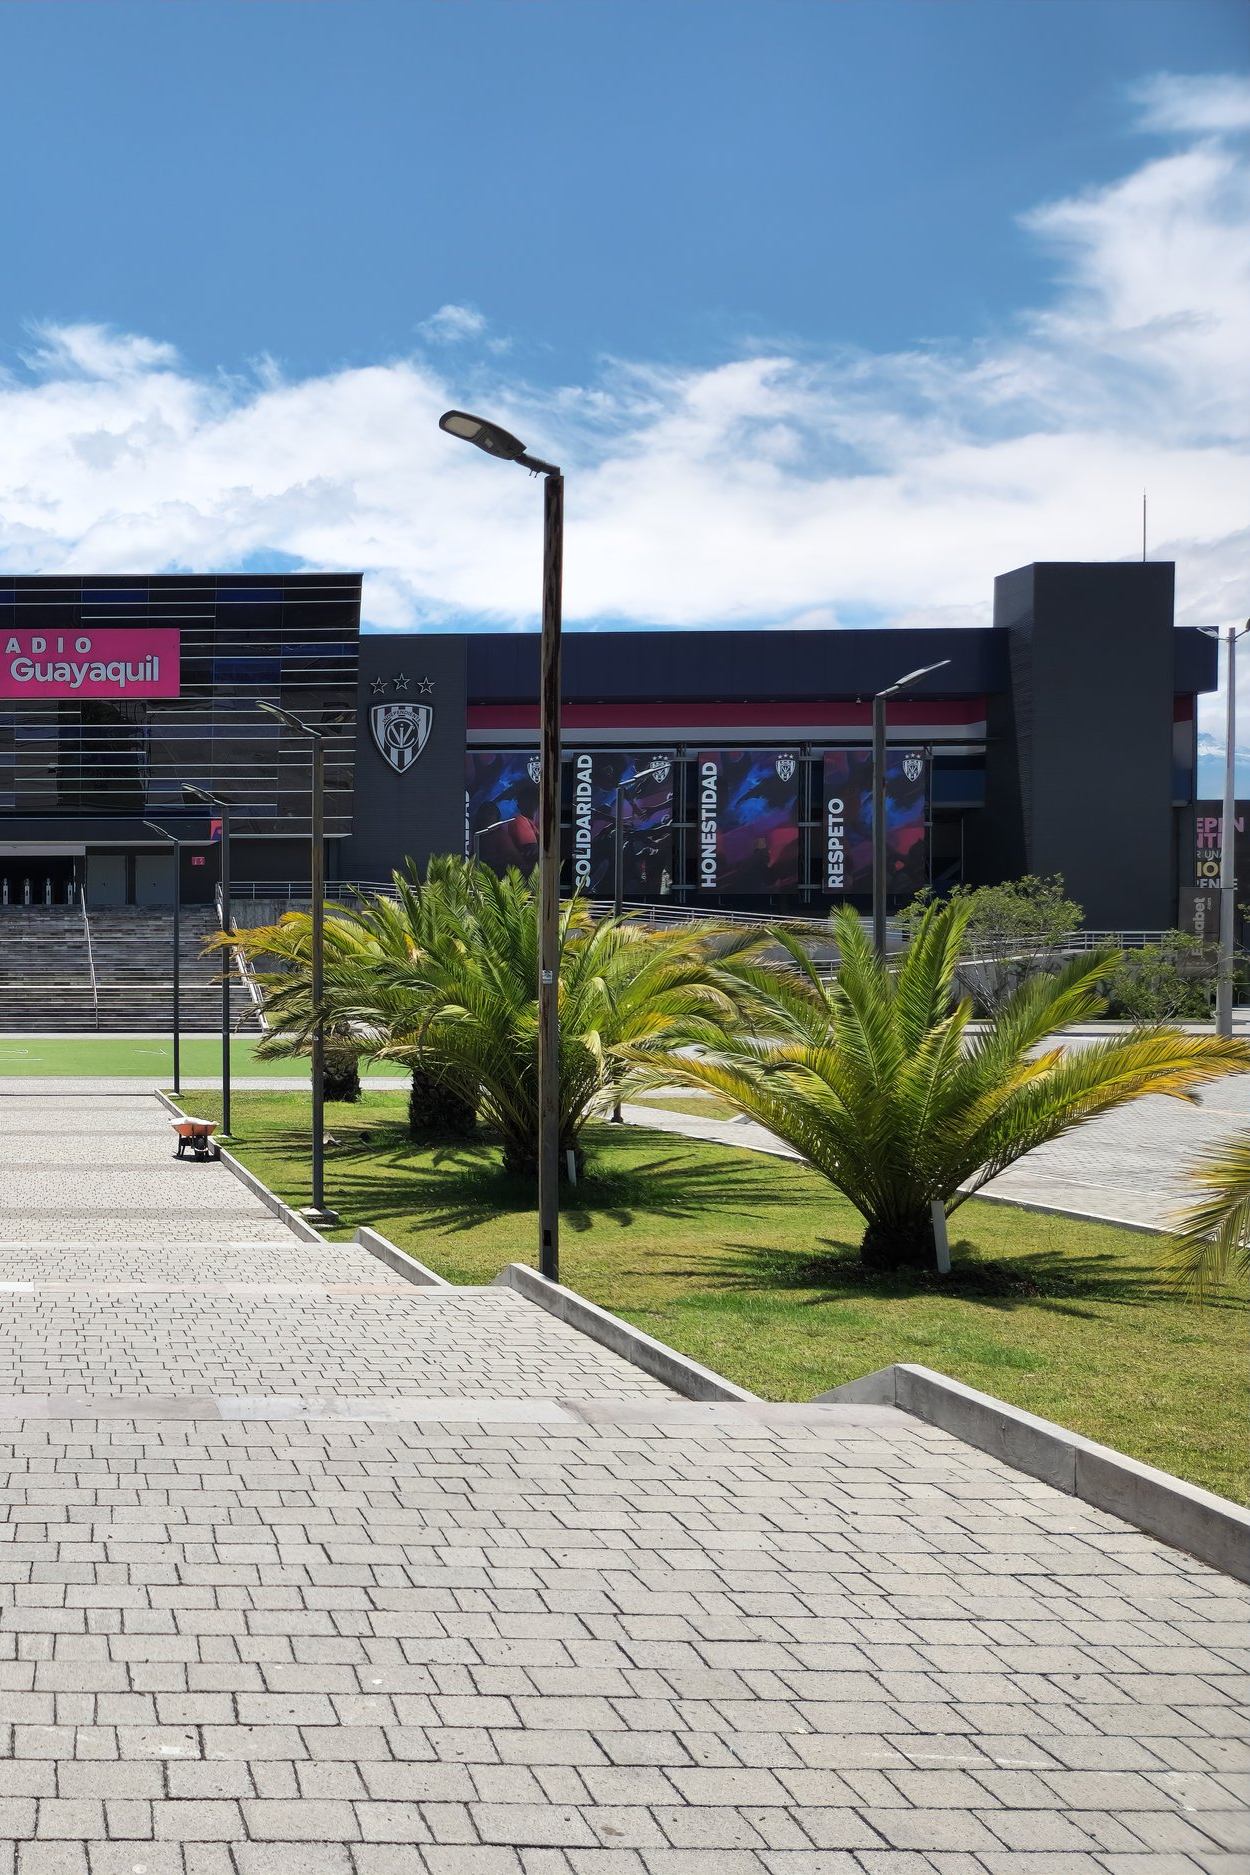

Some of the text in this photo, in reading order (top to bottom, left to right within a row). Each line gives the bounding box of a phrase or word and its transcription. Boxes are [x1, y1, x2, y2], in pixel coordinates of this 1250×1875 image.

[10, 654, 159, 688] Guayaquil
[575, 754, 593, 888] SOLIDARIDAD
[701, 762, 718, 888] HONESTIDAD
[827, 798, 845, 888] RESPETO
